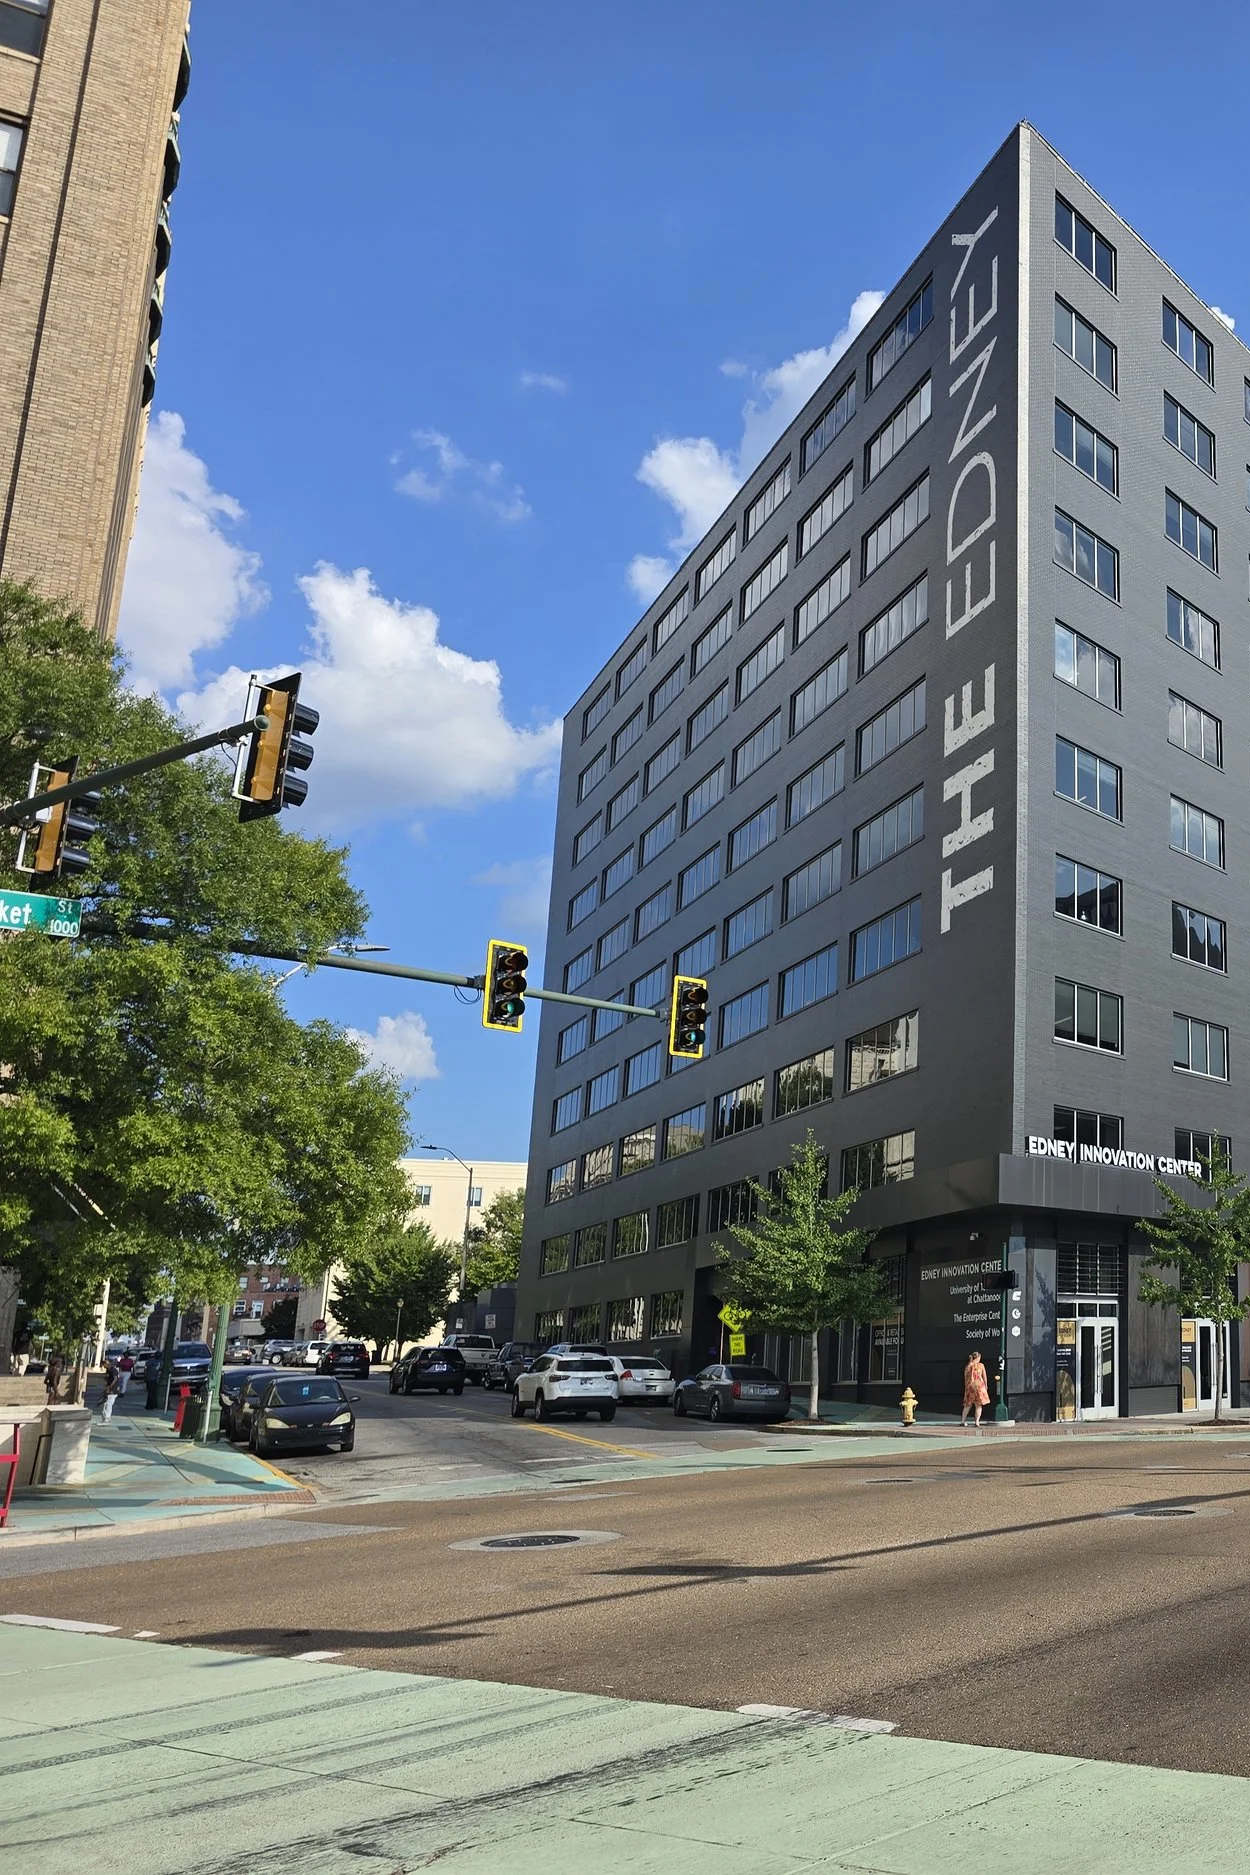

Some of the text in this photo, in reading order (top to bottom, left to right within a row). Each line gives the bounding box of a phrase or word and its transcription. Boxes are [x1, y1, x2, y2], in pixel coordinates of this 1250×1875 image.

[940, 205, 998, 934] THE EDNEY
[57, 900, 73, 914] St
[1028, 1135, 1202, 1178] EDNEY INNOVATION CENTER
[921, 1260, 1002, 1281] EDNEY INNOVATION CENTE
[949, 1283, 973, 1295] University
[974, 1282, 981, 1292] of
[967, 1294, 973, 1304] at
[953, 1310, 1001, 1323] The Enterprise Cent
[965, 1327, 1001, 1339] Society of Wo
